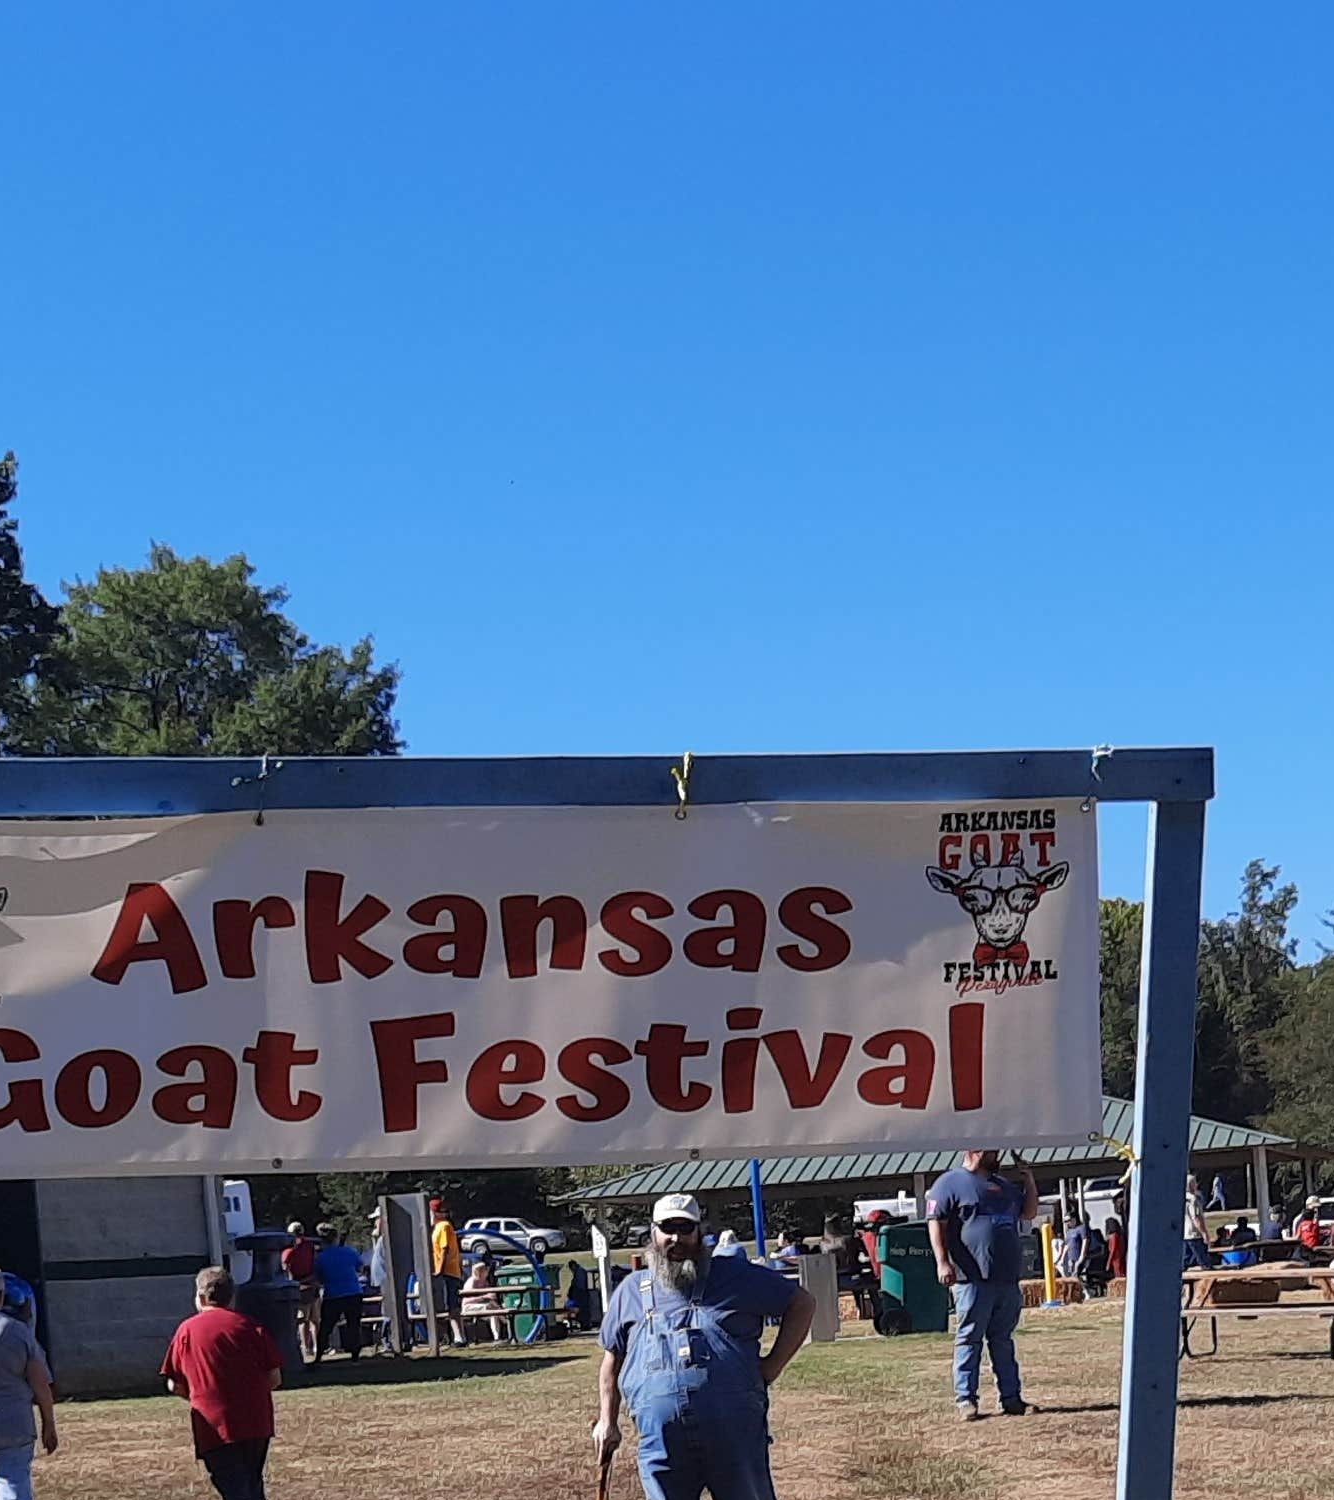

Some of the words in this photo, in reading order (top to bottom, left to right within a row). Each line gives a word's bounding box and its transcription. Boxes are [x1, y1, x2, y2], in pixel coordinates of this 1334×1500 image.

[939, 809, 1056, 832] ARKANSAS
[939, 831, 1055, 870] GOAT
[90, 869, 853, 995] Arkansas
[944, 960, 1058, 983] FESTIVAL
[370, 1002, 986, 1134] Festival
